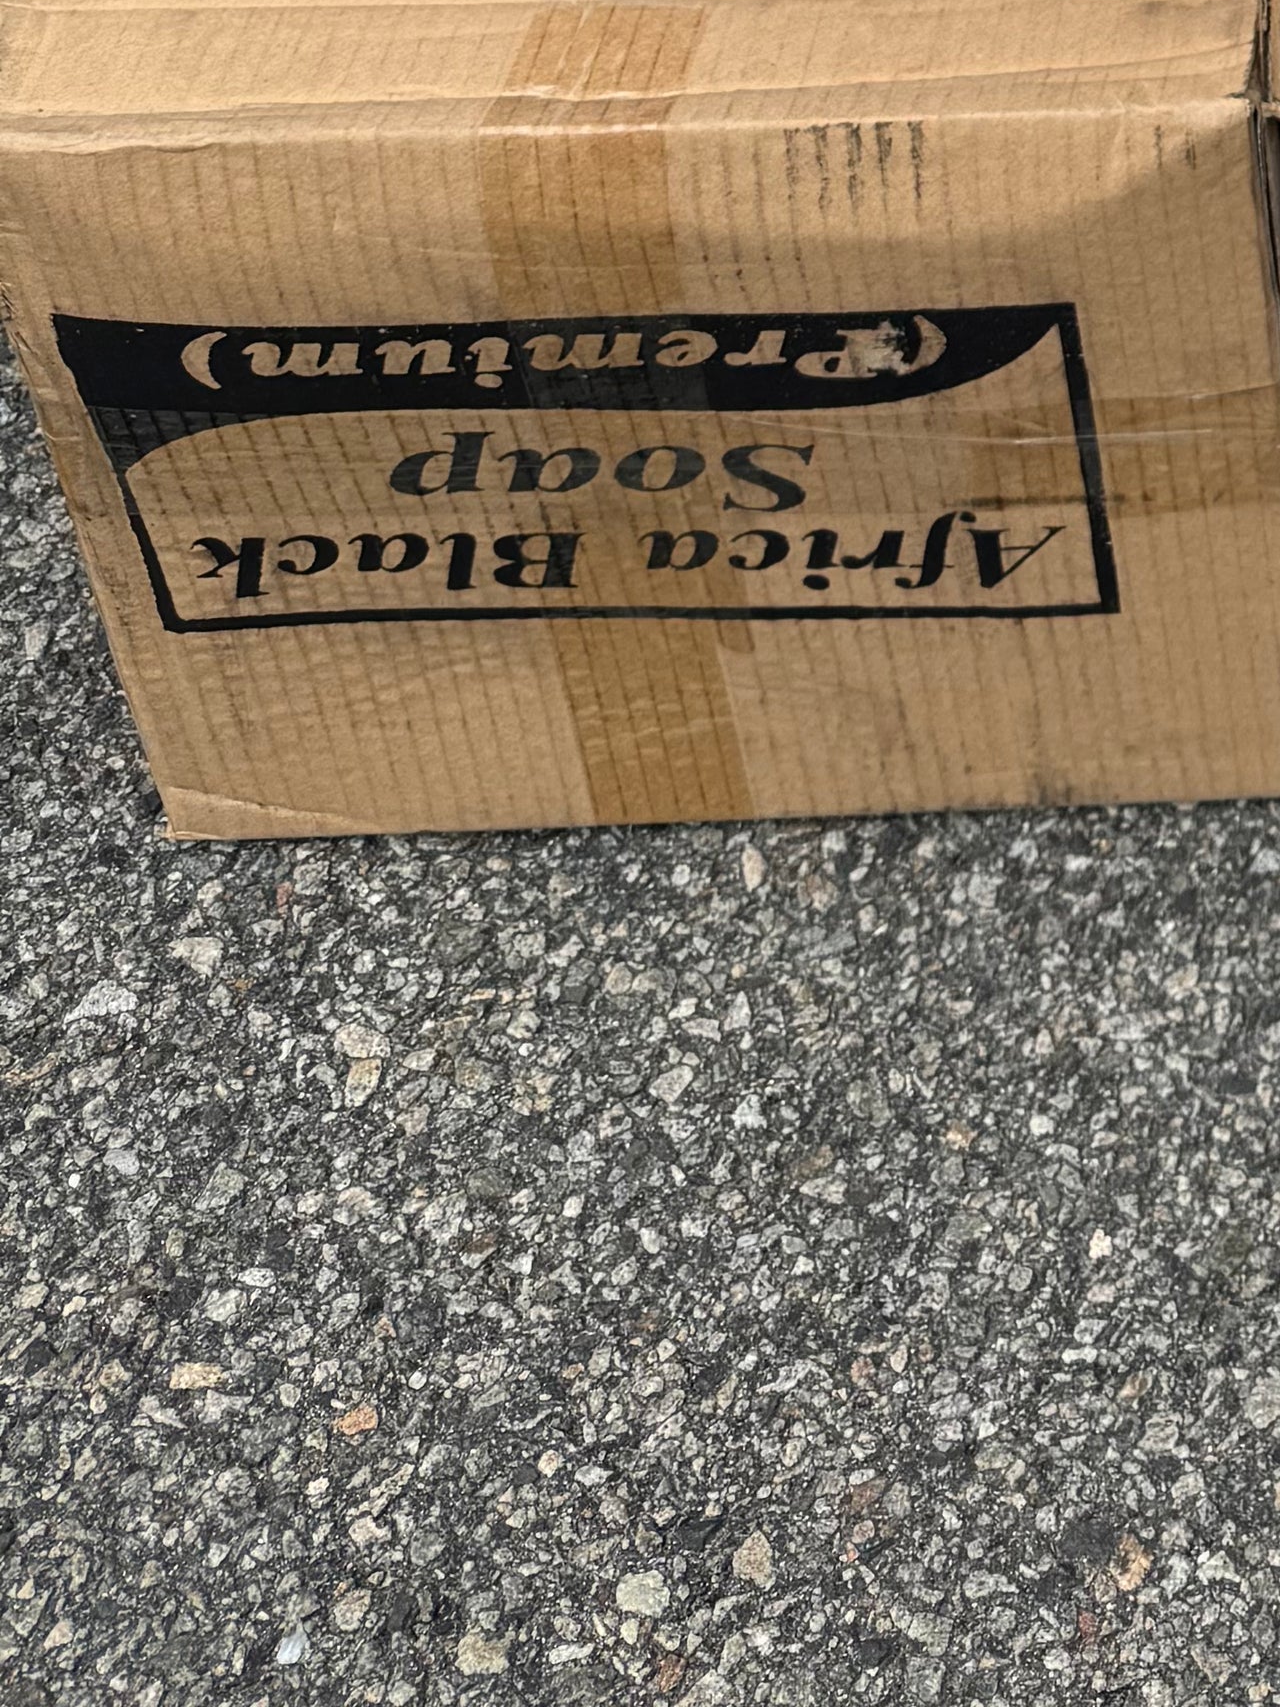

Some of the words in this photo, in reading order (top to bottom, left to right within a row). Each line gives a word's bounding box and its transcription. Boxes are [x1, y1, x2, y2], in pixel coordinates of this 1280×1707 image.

[180, 314, 948, 390] (Premium)
[388, 430, 816, 514] Soap
[188, 530, 588, 598] Black
[636, 509, 1069, 591] Africa
